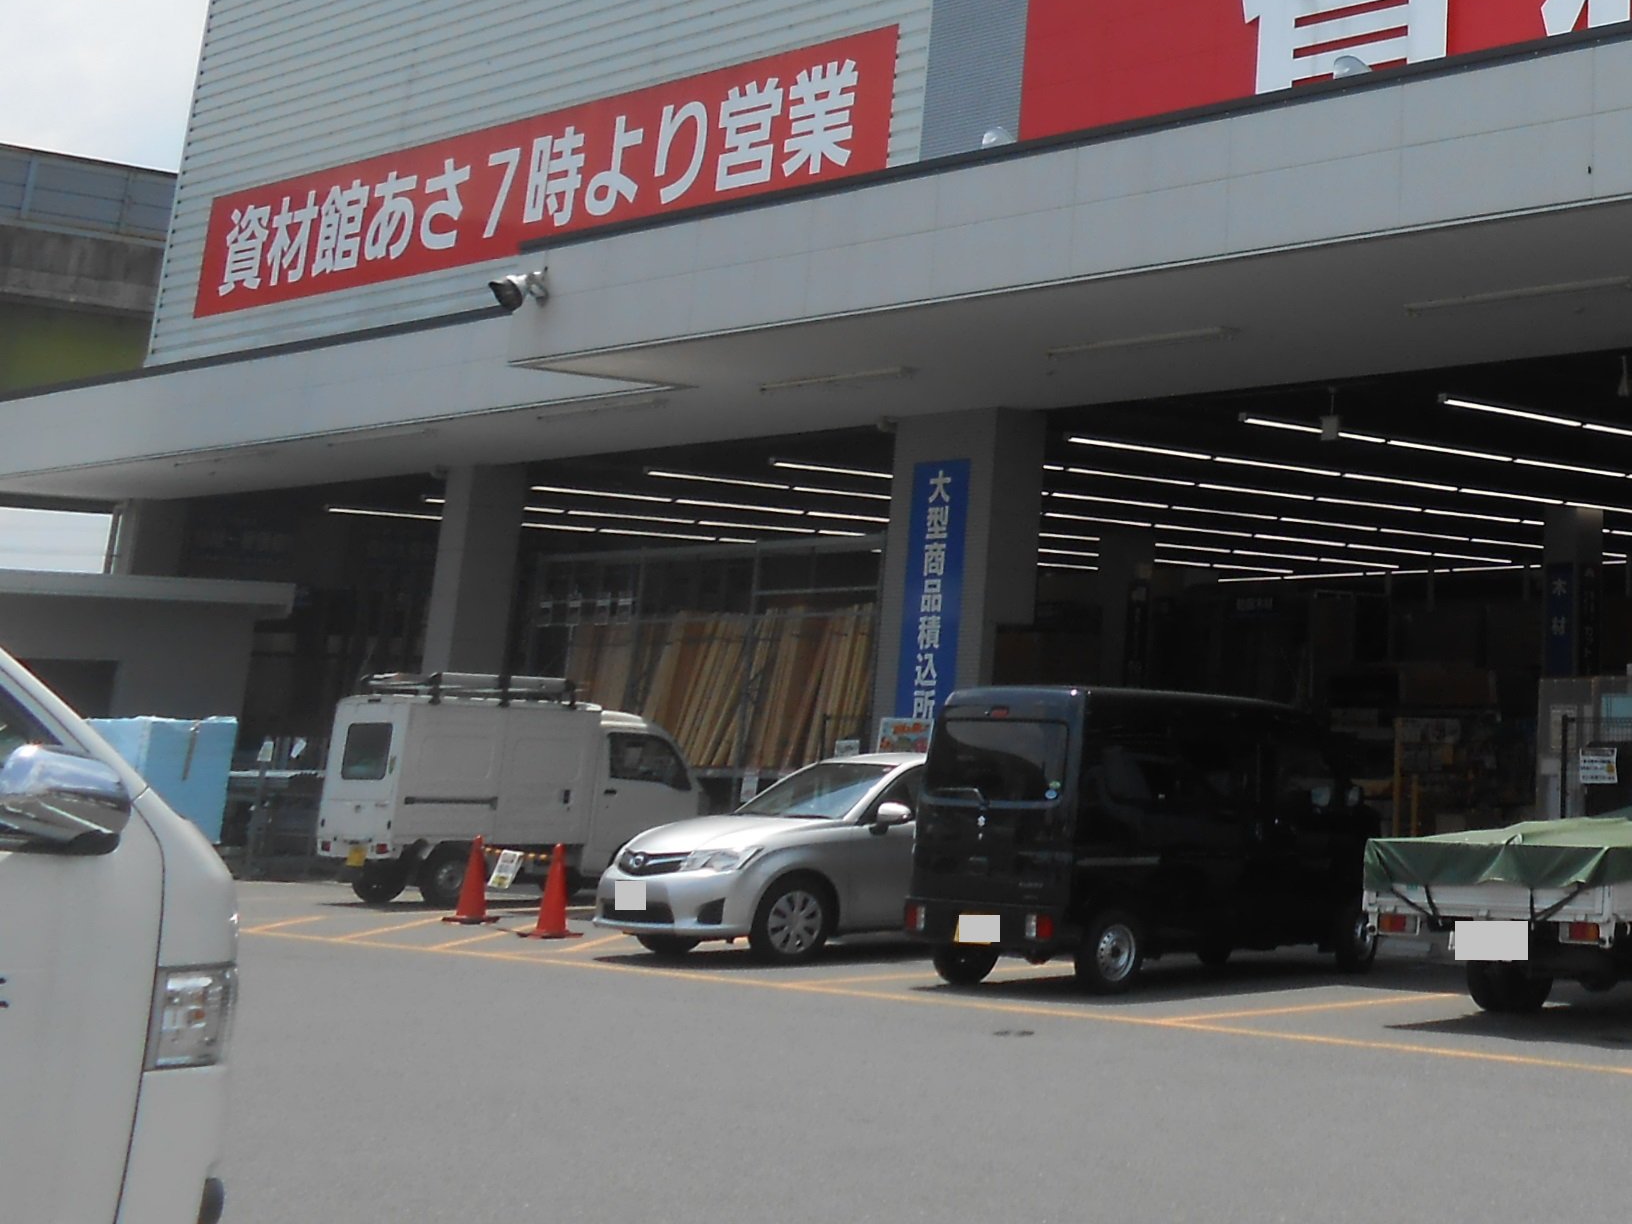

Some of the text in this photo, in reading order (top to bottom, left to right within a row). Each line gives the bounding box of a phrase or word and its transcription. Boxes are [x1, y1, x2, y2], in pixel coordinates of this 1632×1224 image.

[912, 469, 952, 720] 大型商品積込所
